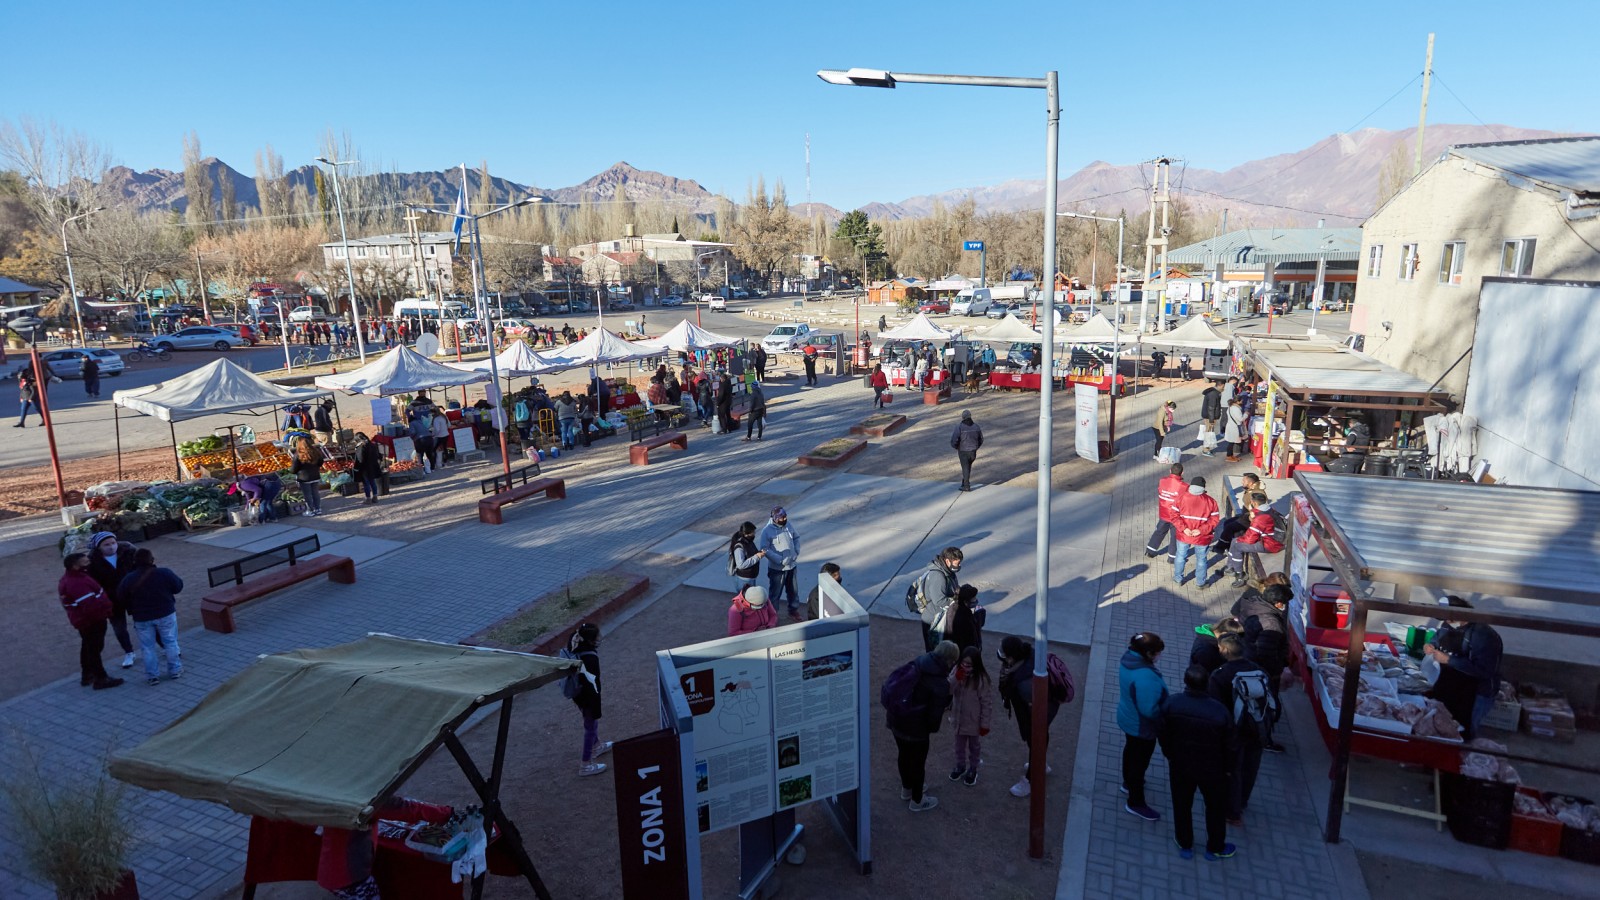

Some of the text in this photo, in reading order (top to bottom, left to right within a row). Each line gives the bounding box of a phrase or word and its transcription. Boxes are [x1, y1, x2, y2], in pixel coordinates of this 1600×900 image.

[685, 676, 696, 692] 1
[637, 765, 666, 865] ZONA 1
